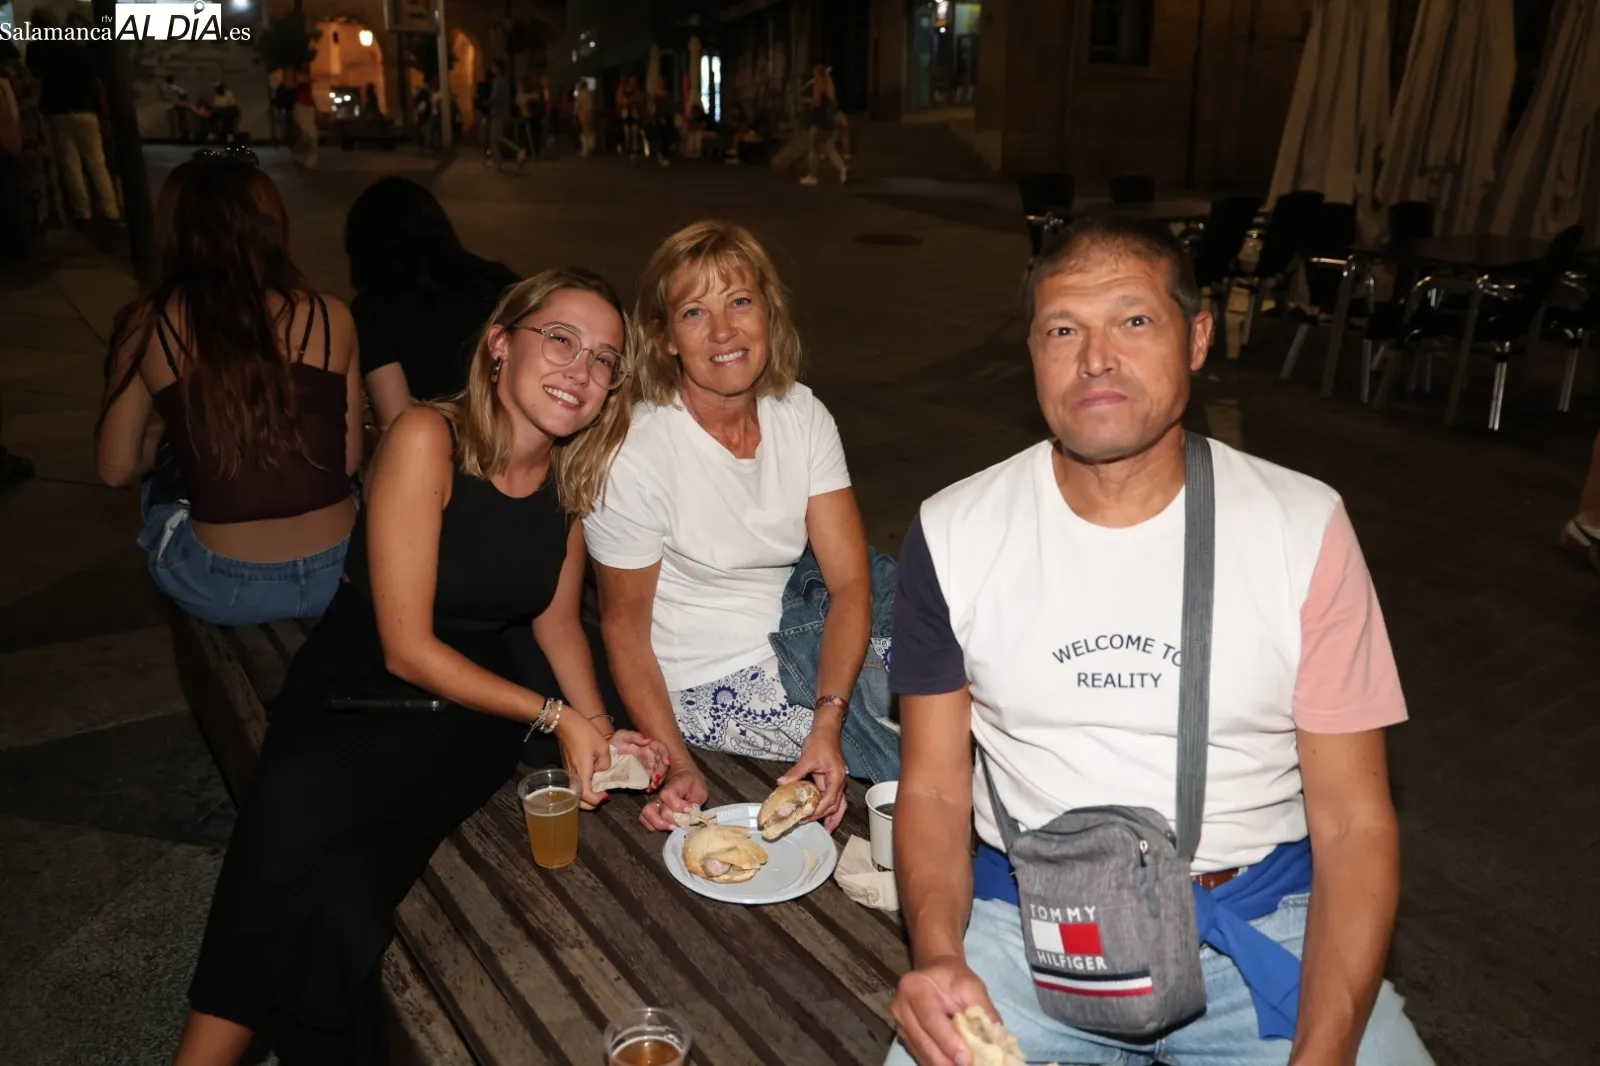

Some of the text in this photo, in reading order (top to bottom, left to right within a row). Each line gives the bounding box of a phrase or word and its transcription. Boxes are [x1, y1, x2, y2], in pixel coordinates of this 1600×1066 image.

[1052, 634, 1156, 664] WELCOME
[1077, 672, 1163, 688] REALITY
[1029, 903, 1096, 922] TOMMY
[1036, 950, 1108, 971] HILFIGER
